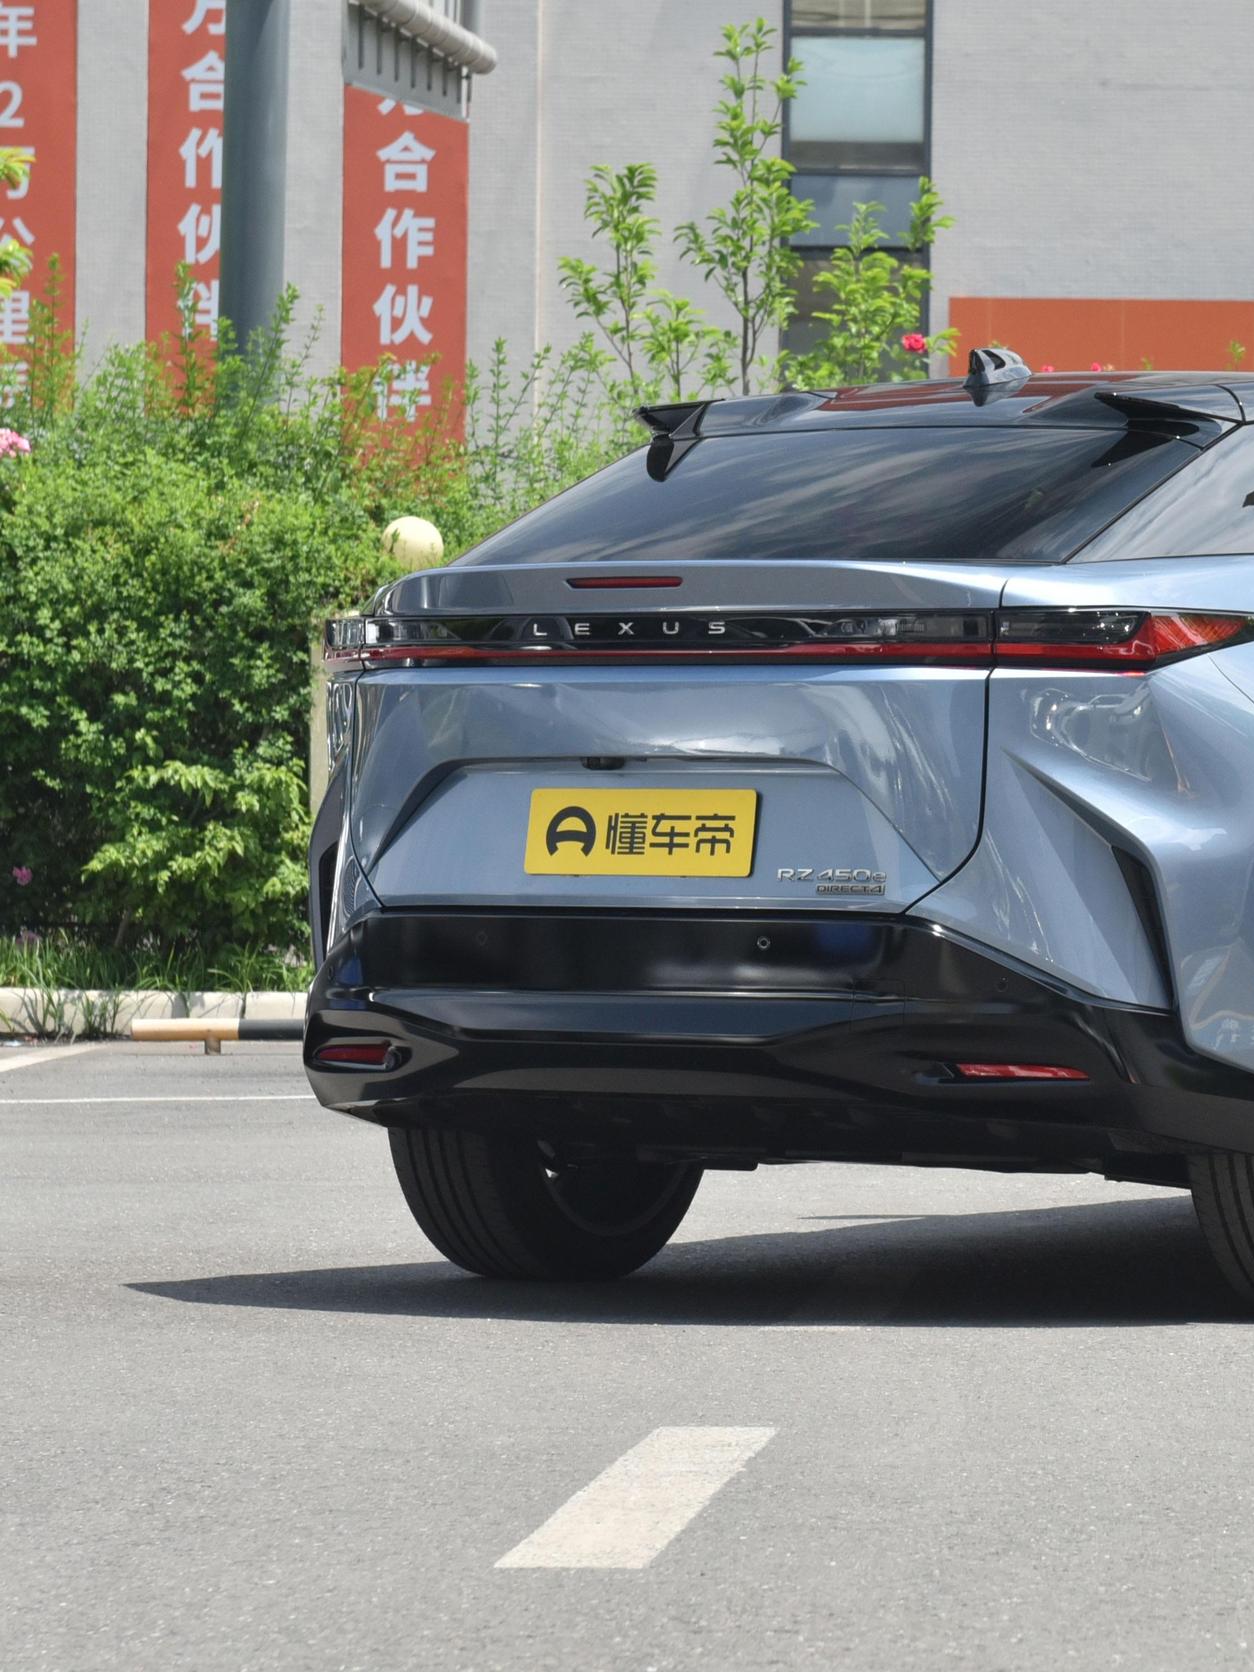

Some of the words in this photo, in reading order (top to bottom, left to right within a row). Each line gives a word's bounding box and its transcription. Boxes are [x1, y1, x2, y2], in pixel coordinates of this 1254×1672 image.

[373, 98, 436, 422] 合作伙伴
[533, 621, 727, 636] LEXUS
[605, 812, 736, 856] 懂车帝
[776, 868, 814, 882] RZ
[816, 868, 888, 883] 450e
